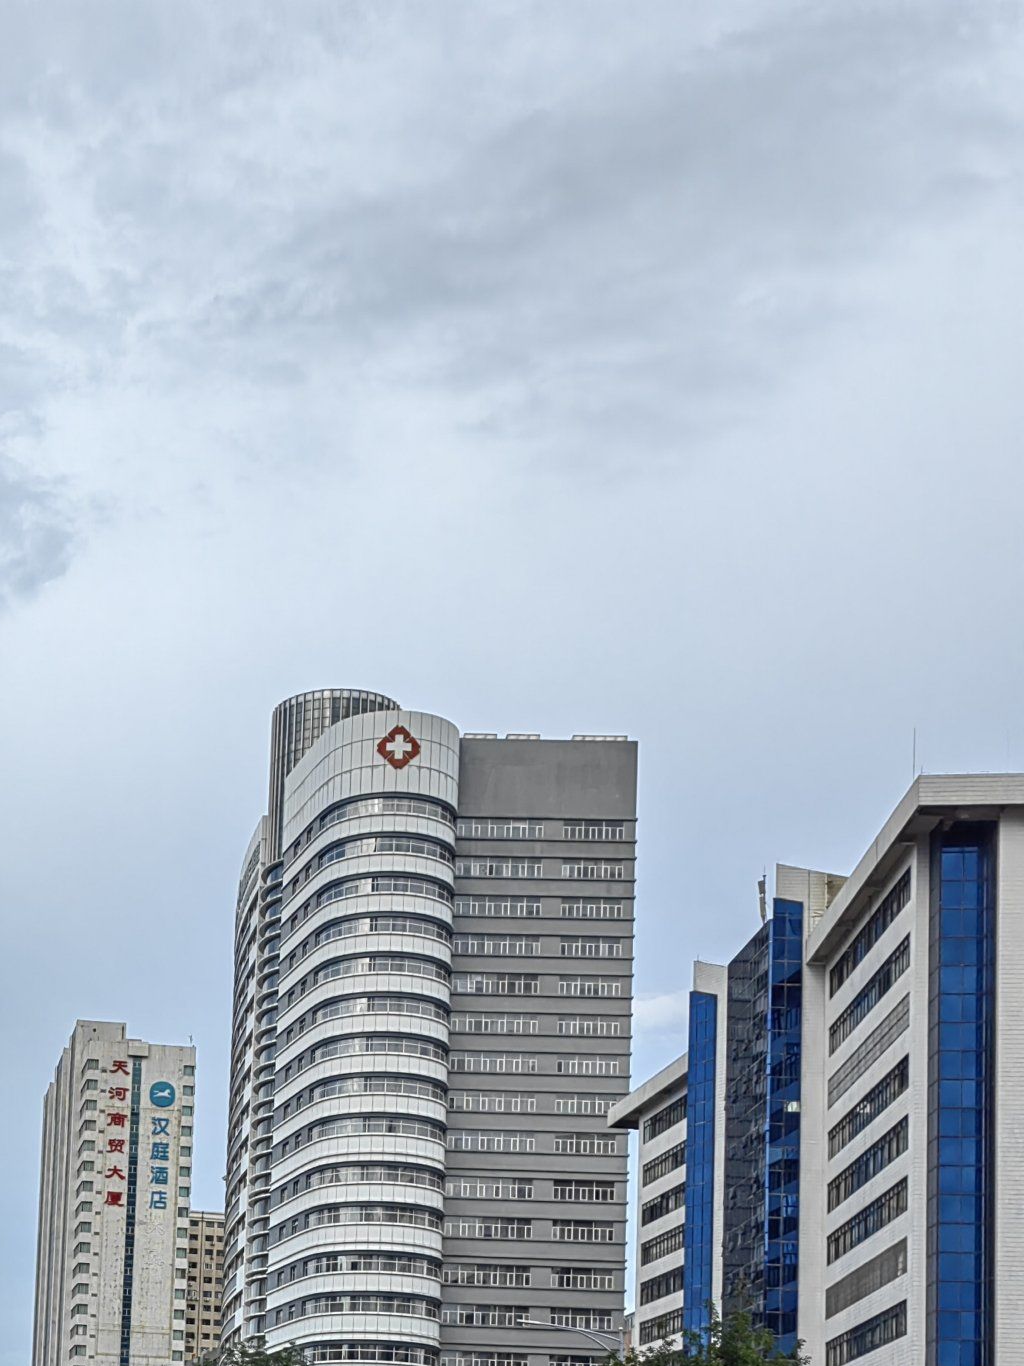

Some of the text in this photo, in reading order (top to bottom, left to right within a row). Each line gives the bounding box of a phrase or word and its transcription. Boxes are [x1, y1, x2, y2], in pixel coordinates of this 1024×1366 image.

[104, 1060, 130, 1208] 天河商贸大厦
[149, 1116, 171, 1210] 汉庭酒店
